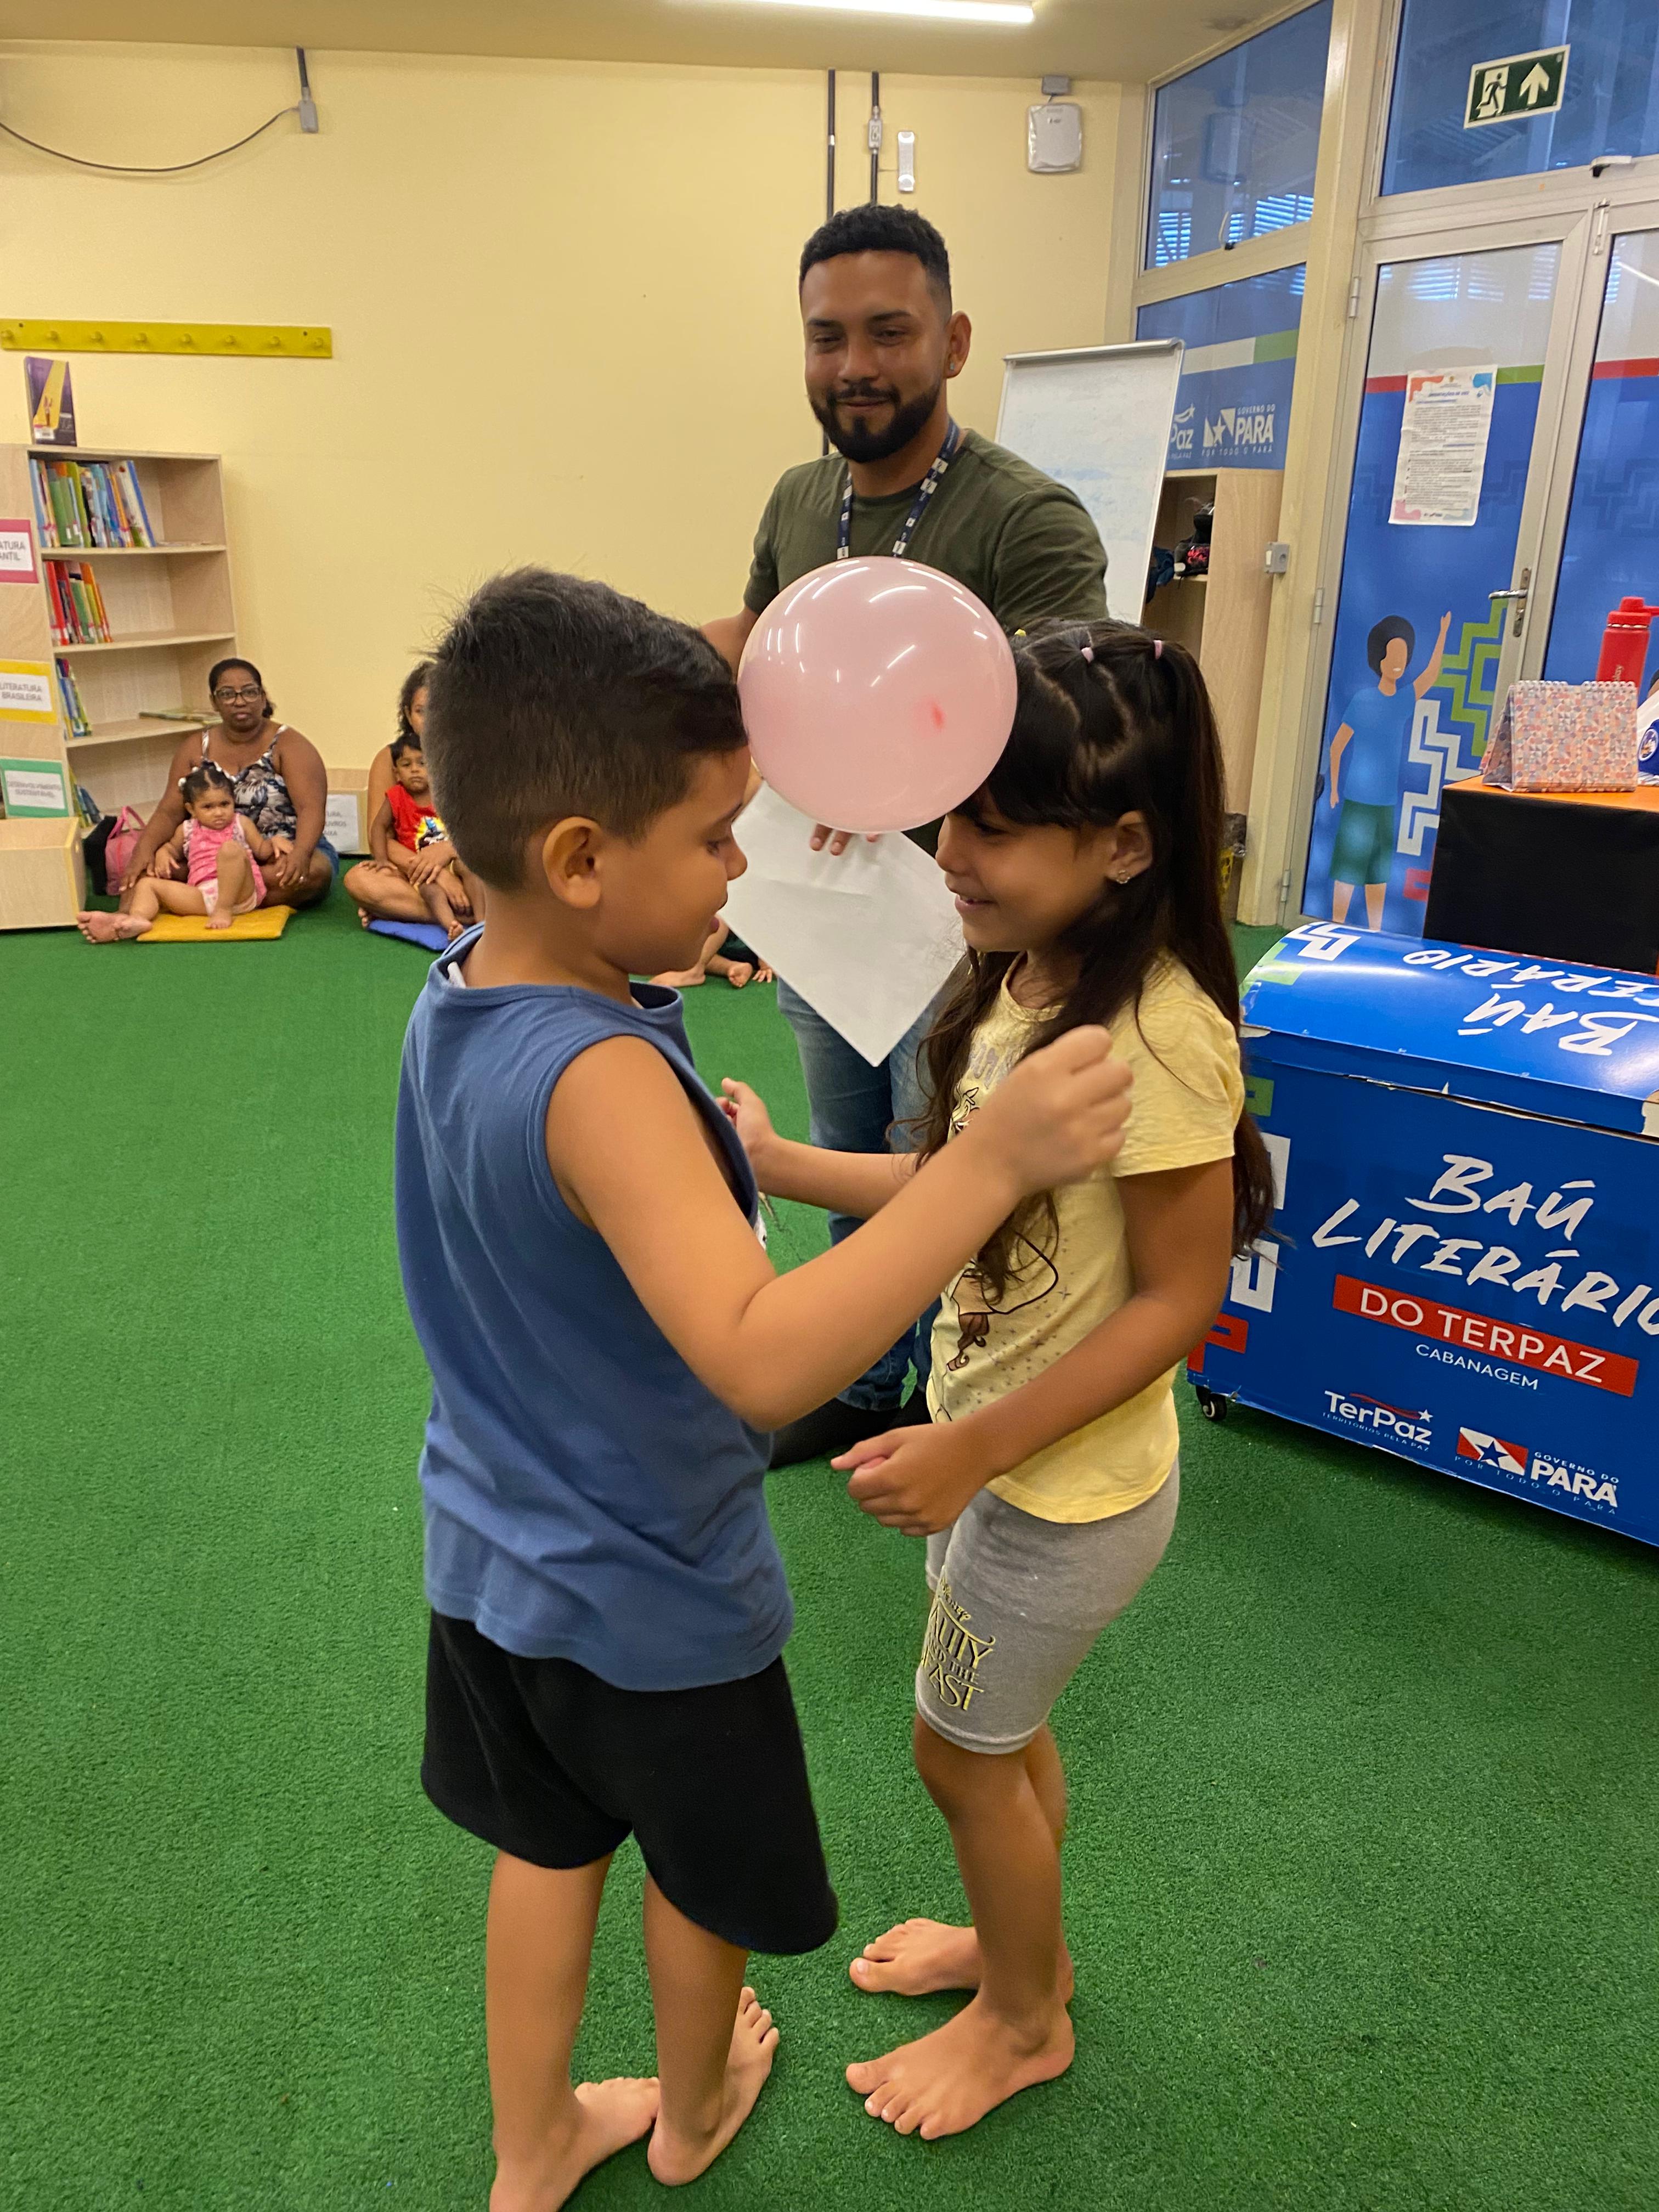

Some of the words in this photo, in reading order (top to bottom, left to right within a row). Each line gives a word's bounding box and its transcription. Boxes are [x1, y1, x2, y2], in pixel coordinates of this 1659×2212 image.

[1238, 404, 1265, 415] GOVERNO
[1267, 404, 1276, 412] DO
[1220, 448, 1239, 456] TODO
[2, 691, 43, 701] BRASILEIRA
[1457, 992, 1659, 1056] BAÚ
[1405, 1154, 1595, 1241] BAÚ
[1360, 1288, 1424, 1327] DO
[1437, 1310, 1606, 1383] TERPAZ
[1416, 1344, 1539, 1391] CABANAGEM
[1324, 1390, 1432, 1446] TerPaz
[1455, 1456, 1483, 1469] POR
[1497, 1470, 1539, 1488] TODO
[1534, 1451, 1595, 1476] GOVERNO
[1601, 1473, 1619, 1484] DO
[950, 1661, 980, 1684] THE
